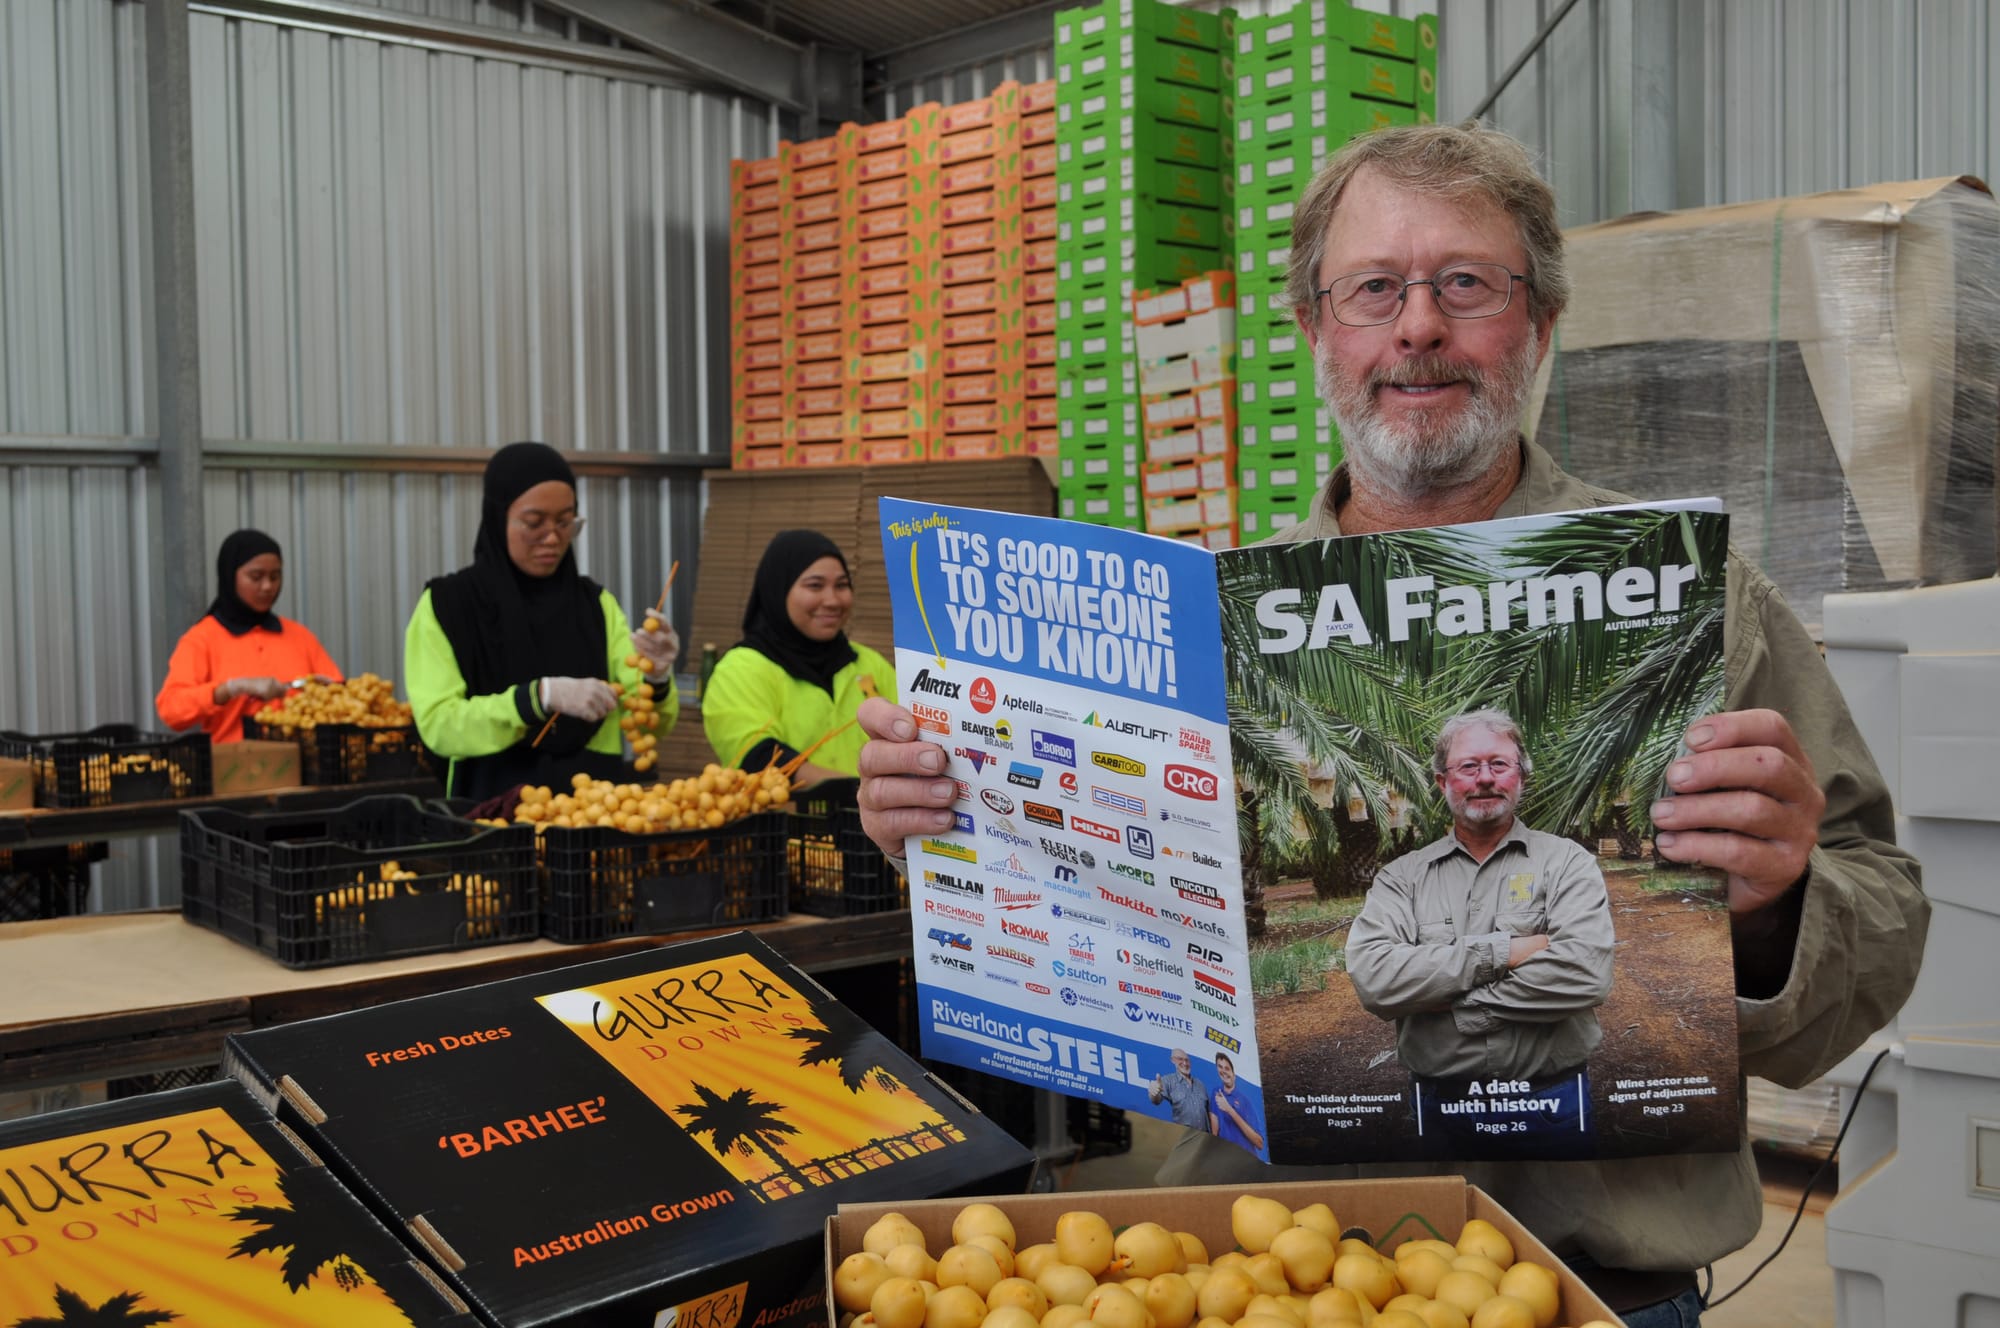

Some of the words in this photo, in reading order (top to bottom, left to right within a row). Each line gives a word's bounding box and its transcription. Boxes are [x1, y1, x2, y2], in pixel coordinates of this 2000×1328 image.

[888, 520, 912, 540] This
[912, 516, 923, 534] is
[936, 528, 990, 568] IT'S
[998, 537, 1078, 583] GOOD
[1086, 550, 1125, 590] TO
[1133, 558, 1170, 601] GO
[940, 562, 986, 608] TO
[996, 572, 1174, 646] SOMEONE
[1254, 583, 1373, 655] SA
[1386, 563, 1698, 643] Farmer
[1325, 623, 1354, 632] TAYLOR
[1604, 616, 1650, 633] AUTUMN
[1651, 614, 1680, 628] 2025
[944, 603, 1024, 663] YOU
[1037, 620, 1178, 698] KNOW!
[910, 669, 962, 700] AIRTEX
[912, 703, 949, 722] BAHCO
[1002, 694, 1044, 714] Aptella
[961, 720, 995, 738] BEAVER
[1104, 719, 1169, 742] AUSTLIFT
[1179, 731, 1212, 746] TRAILER
[984, 736, 1014, 751] BRANDS
[1043, 742, 1072, 760] BORDO
[1179, 739, 1210, 754] SPARES
[1010, 774, 1037, 787] Dy-Mark
[1167, 769, 1214, 796] CRC
[1026, 804, 1059, 820] GORILLA
[985, 825, 1033, 848] Kingspan
[1074, 818, 1118, 842] HILTI
[931, 838, 967, 854] Manutec
[1039, 837, 1078, 856] KLEIN
[1041, 846, 1079, 865] TOOLS
[1192, 851, 1222, 869] Buildex
[985, 864, 1036, 883] SAINT-GOBAIN
[992, 886, 1042, 904] Milwaukee
[1044, 880, 1091, 900] macnaught
[1172, 877, 1216, 898] LINCOLN
[1097, 885, 1158, 918] makita
[1183, 892, 1222, 908] ELECTRIC
[937, 903, 985, 922] RICHMOND
[1063, 908, 1106, 925] PEERLESS
[1008, 922, 1049, 943] ROMAK
[1132, 926, 1171, 949] PFERD
[1068, 933, 1096, 952] SA
[986, 945, 1036, 967] SUNRISE
[1069, 948, 1095, 961] TRAILERS
[1187, 942, 1224, 963] PIP
[940, 955, 975, 973] VATER
[1133, 952, 1184, 978] Sheffield
[1133, 966, 1157, 977] GROUP
[1186, 953, 1210, 967] GLOBAL
[1211, 962, 1234, 977] SAFETY
[1067, 966, 1107, 986] sutton
[1026, 982, 1049, 995] LOCKER
[1132, 983, 1182, 1001] TRADEQUIP
[1194, 980, 1237, 1007] SOUDAL
[592, 969, 791, 1042] GURRA
[1078, 994, 1114, 1010] Weldclass
[1145, 1010, 1193, 1031] WHITE
[1190, 999, 1230, 1025] TRIDON
[639, 1012, 804, 1061] DOWNS
[932, 1000, 1023, 1043] Riverland
[1026, 1028, 1154, 1090] STEEL
[1207, 1027, 1240, 1054] WIA
[365, 1040, 437, 1068] Fresh
[439, 1026, 512, 1052] Dates
[993, 1051, 1088, 1083] riverlandsteel.com.au
[1468, 1081, 1485, 1096] A
[1485, 1079, 1530, 1095] date
[1616, 1079, 1645, 1089] Wine
[1646, 1077, 1682, 1087] sector
[1683, 1076, 1709, 1085] sees
[1285, 1094, 1306, 1104] The
[1307, 1093, 1348, 1105] holiday
[1349, 1092, 1402, 1104] drawcard
[1608, 1091, 1638, 1104] signs
[1639, 1089, 1652, 1100] of
[1653, 1086, 1718, 1100] adjustment
[1304, 1105, 1316, 1115] of
[1317, 1104, 1384, 1115] horticulture
[1440, 1098, 1486, 1115] with
[1490, 1097, 1561, 1114] history
[1642, 1105, 1670, 1117] Page
[1671, 1103, 1685, 1113] 23
[1327, 1118, 1353, 1129] Page
[1355, 1118, 1363, 1127] 2
[1475, 1122, 1508, 1134] Page
[1510, 1121, 1527, 1132] 26
[2, 1184, 260, 1258] DOWNS
[512, 1211, 650, 1268] Australian
[650, 1187, 736, 1224] Grown
